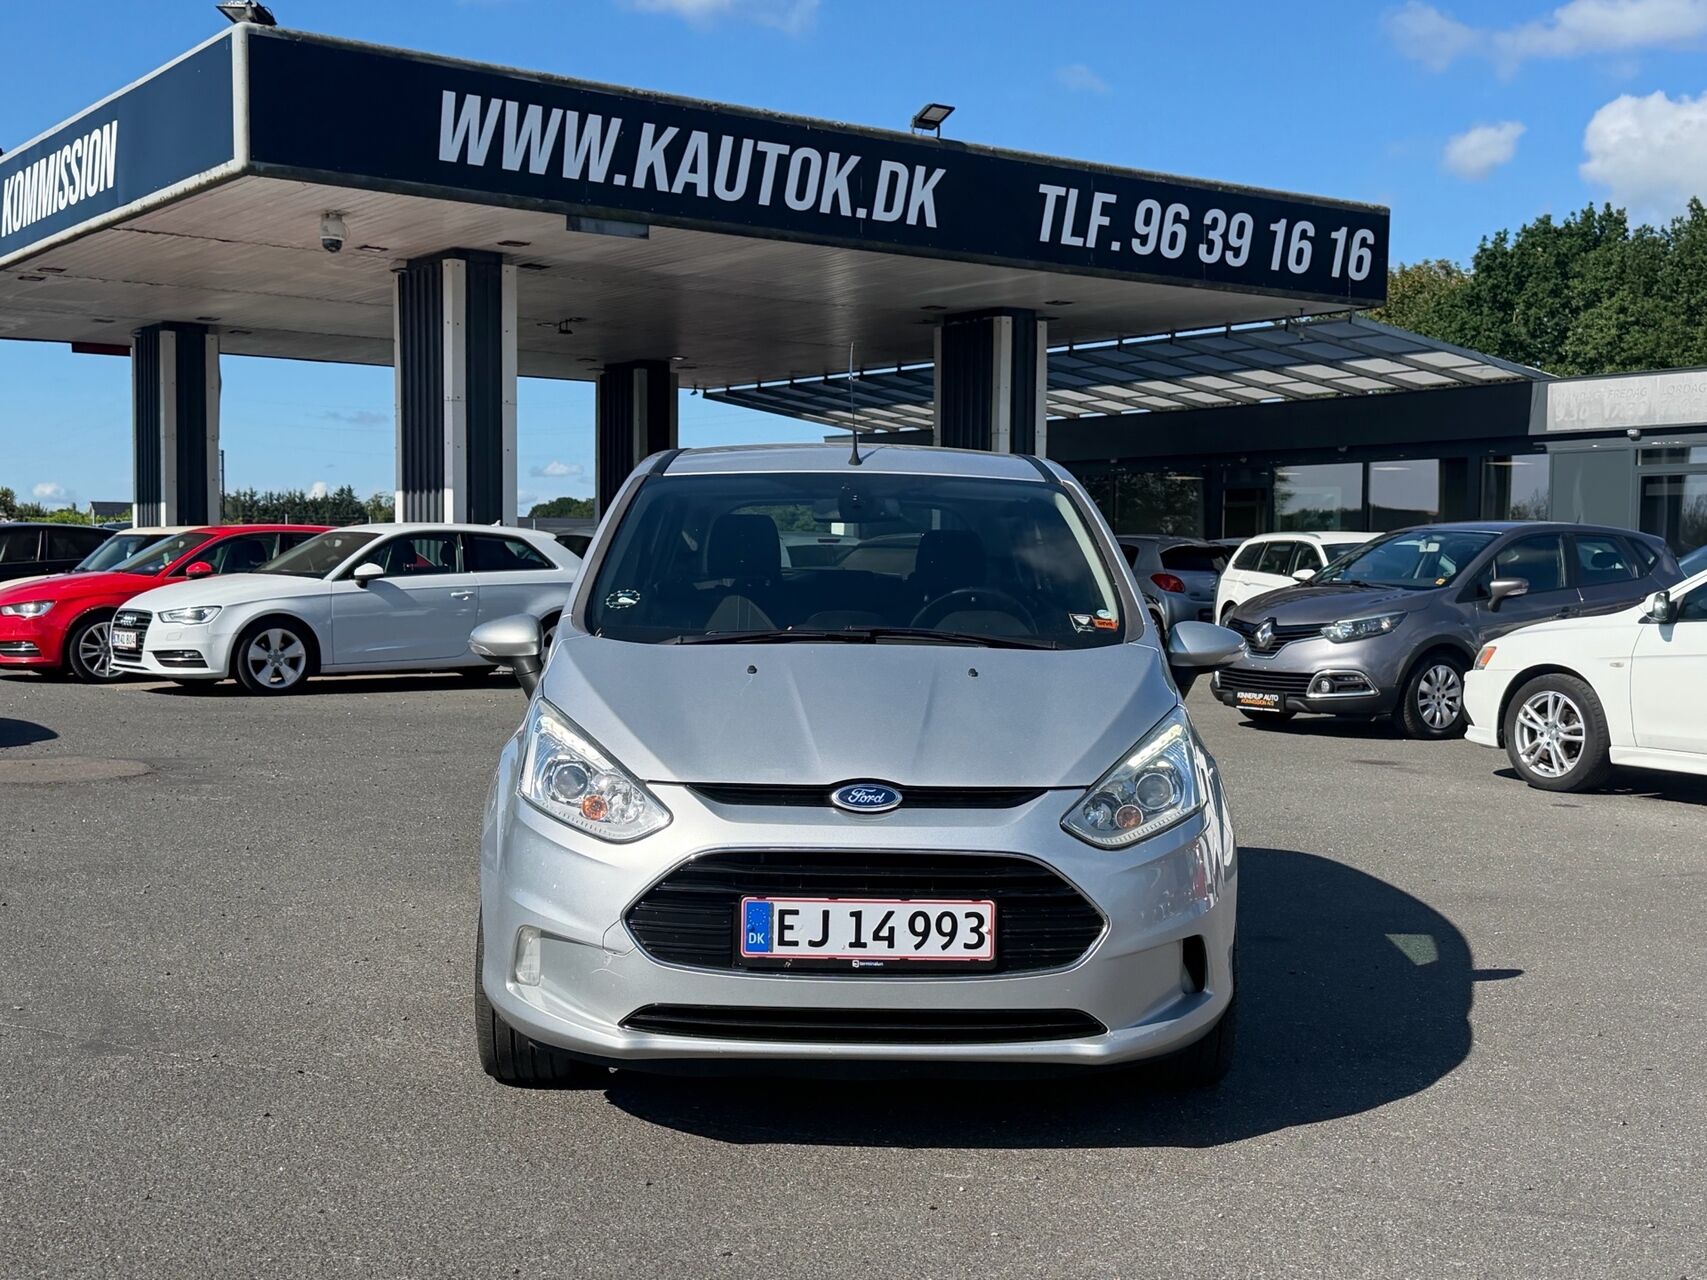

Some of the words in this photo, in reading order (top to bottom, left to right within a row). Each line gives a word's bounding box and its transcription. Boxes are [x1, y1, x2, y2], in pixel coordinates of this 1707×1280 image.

[1, 120, 118, 237] KOMMISSION
[438, 90, 947, 228] WWW.KAUTOK.DK
[1038, 184, 1121, 252] TLF.
[1131, 199, 1190, 259] 96
[1199, 208, 1254, 267] 39
[1269, 218, 1315, 274] 16
[1330, 226, 1376, 281] 16
[848, 788, 885, 803] Ford
[748, 932, 765, 945] DK
[777, 909, 830, 948] EJ
[848, 909, 895, 949] 14
[908, 910, 986, 951] 993
